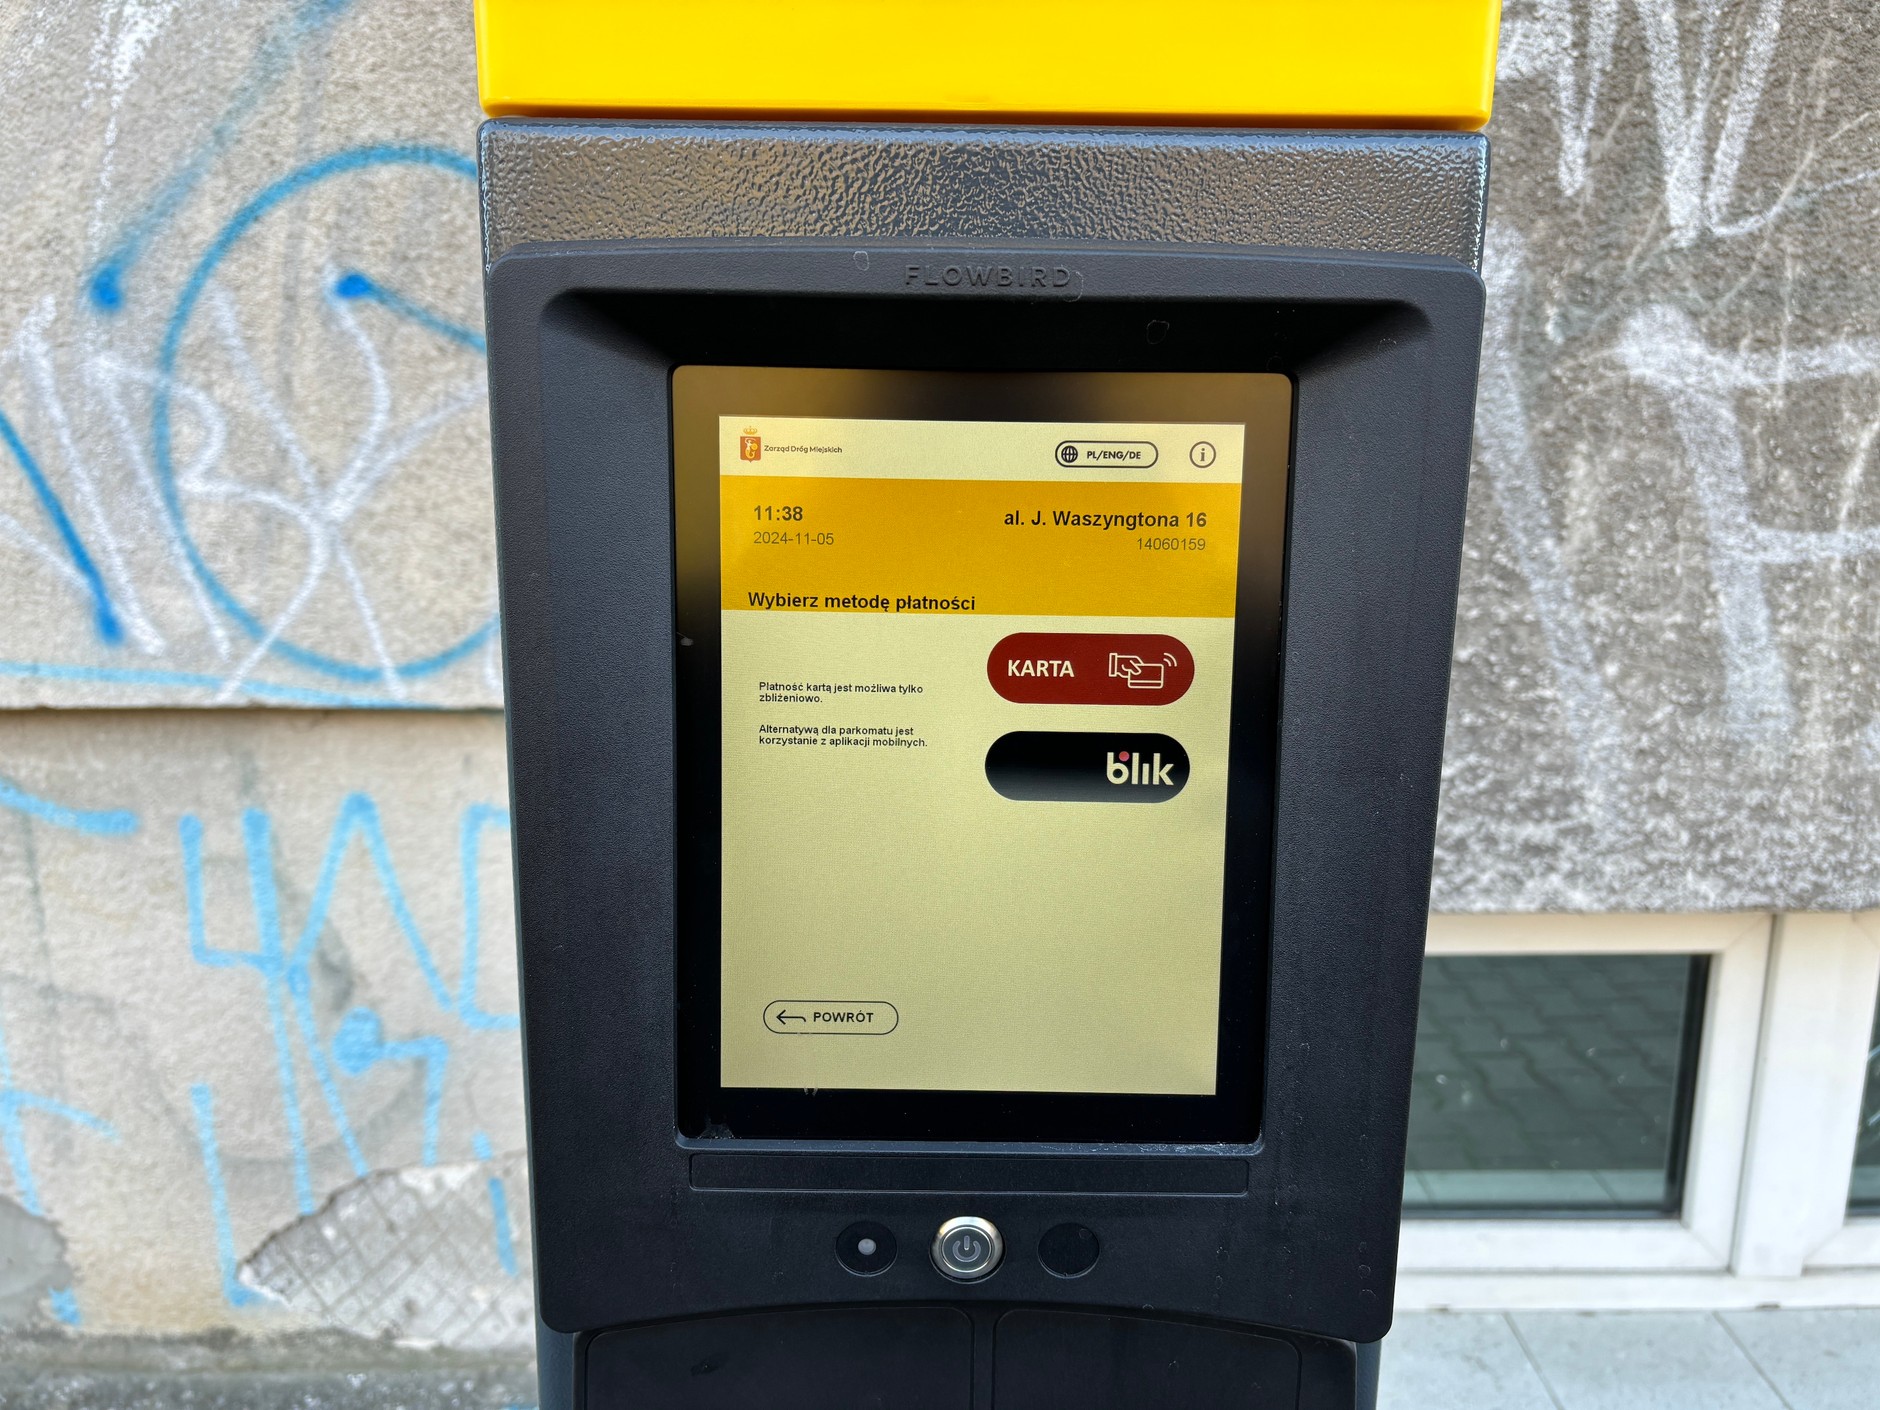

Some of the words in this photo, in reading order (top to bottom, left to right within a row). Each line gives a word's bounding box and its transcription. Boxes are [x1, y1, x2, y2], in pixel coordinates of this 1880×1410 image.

[905, 265, 1071, 287] FLOWBIRD
[764, 445, 790, 453] Zarząd
[791, 444, 808, 453] Dróg
[809, 446, 843, 454] Miejskich
[1086, 450, 1142, 461] PL/ENG/DE
[753, 505, 804, 522] 11:38
[1004, 510, 1025, 526] al.
[1031, 510, 1046, 526] J.
[1053, 511, 1179, 531] Waszyngtona
[1186, 512, 1207, 527] 16
[753, 531, 835, 545] 2024-11-05
[1136, 537, 1206, 551] 14060159
[748, 592, 818, 609] Wybierz
[824, 594, 890, 612] metodę
[896, 595, 976, 612] płatności
[1007, 659, 1075, 678] KARTA
[806, 683, 832, 694] kartą
[833, 684, 852, 694] jest
[853, 683, 898, 694] możliwa
[898, 684, 924, 694] tylko
[759, 693, 823, 703] zbliżeniowo.
[759, 725, 819, 736] Alternatywą
[821, 725, 838, 736] dla
[839, 726, 893, 736] parkomatu
[895, 726, 914, 737] jest
[759, 736, 818, 746] korzystanie
[829, 737, 870, 748] aplikacji
[872, 737, 928, 748] mobilnych.
[1106, 751, 1174, 785] blik
[813, 1010, 874, 1023] POWRÓT
